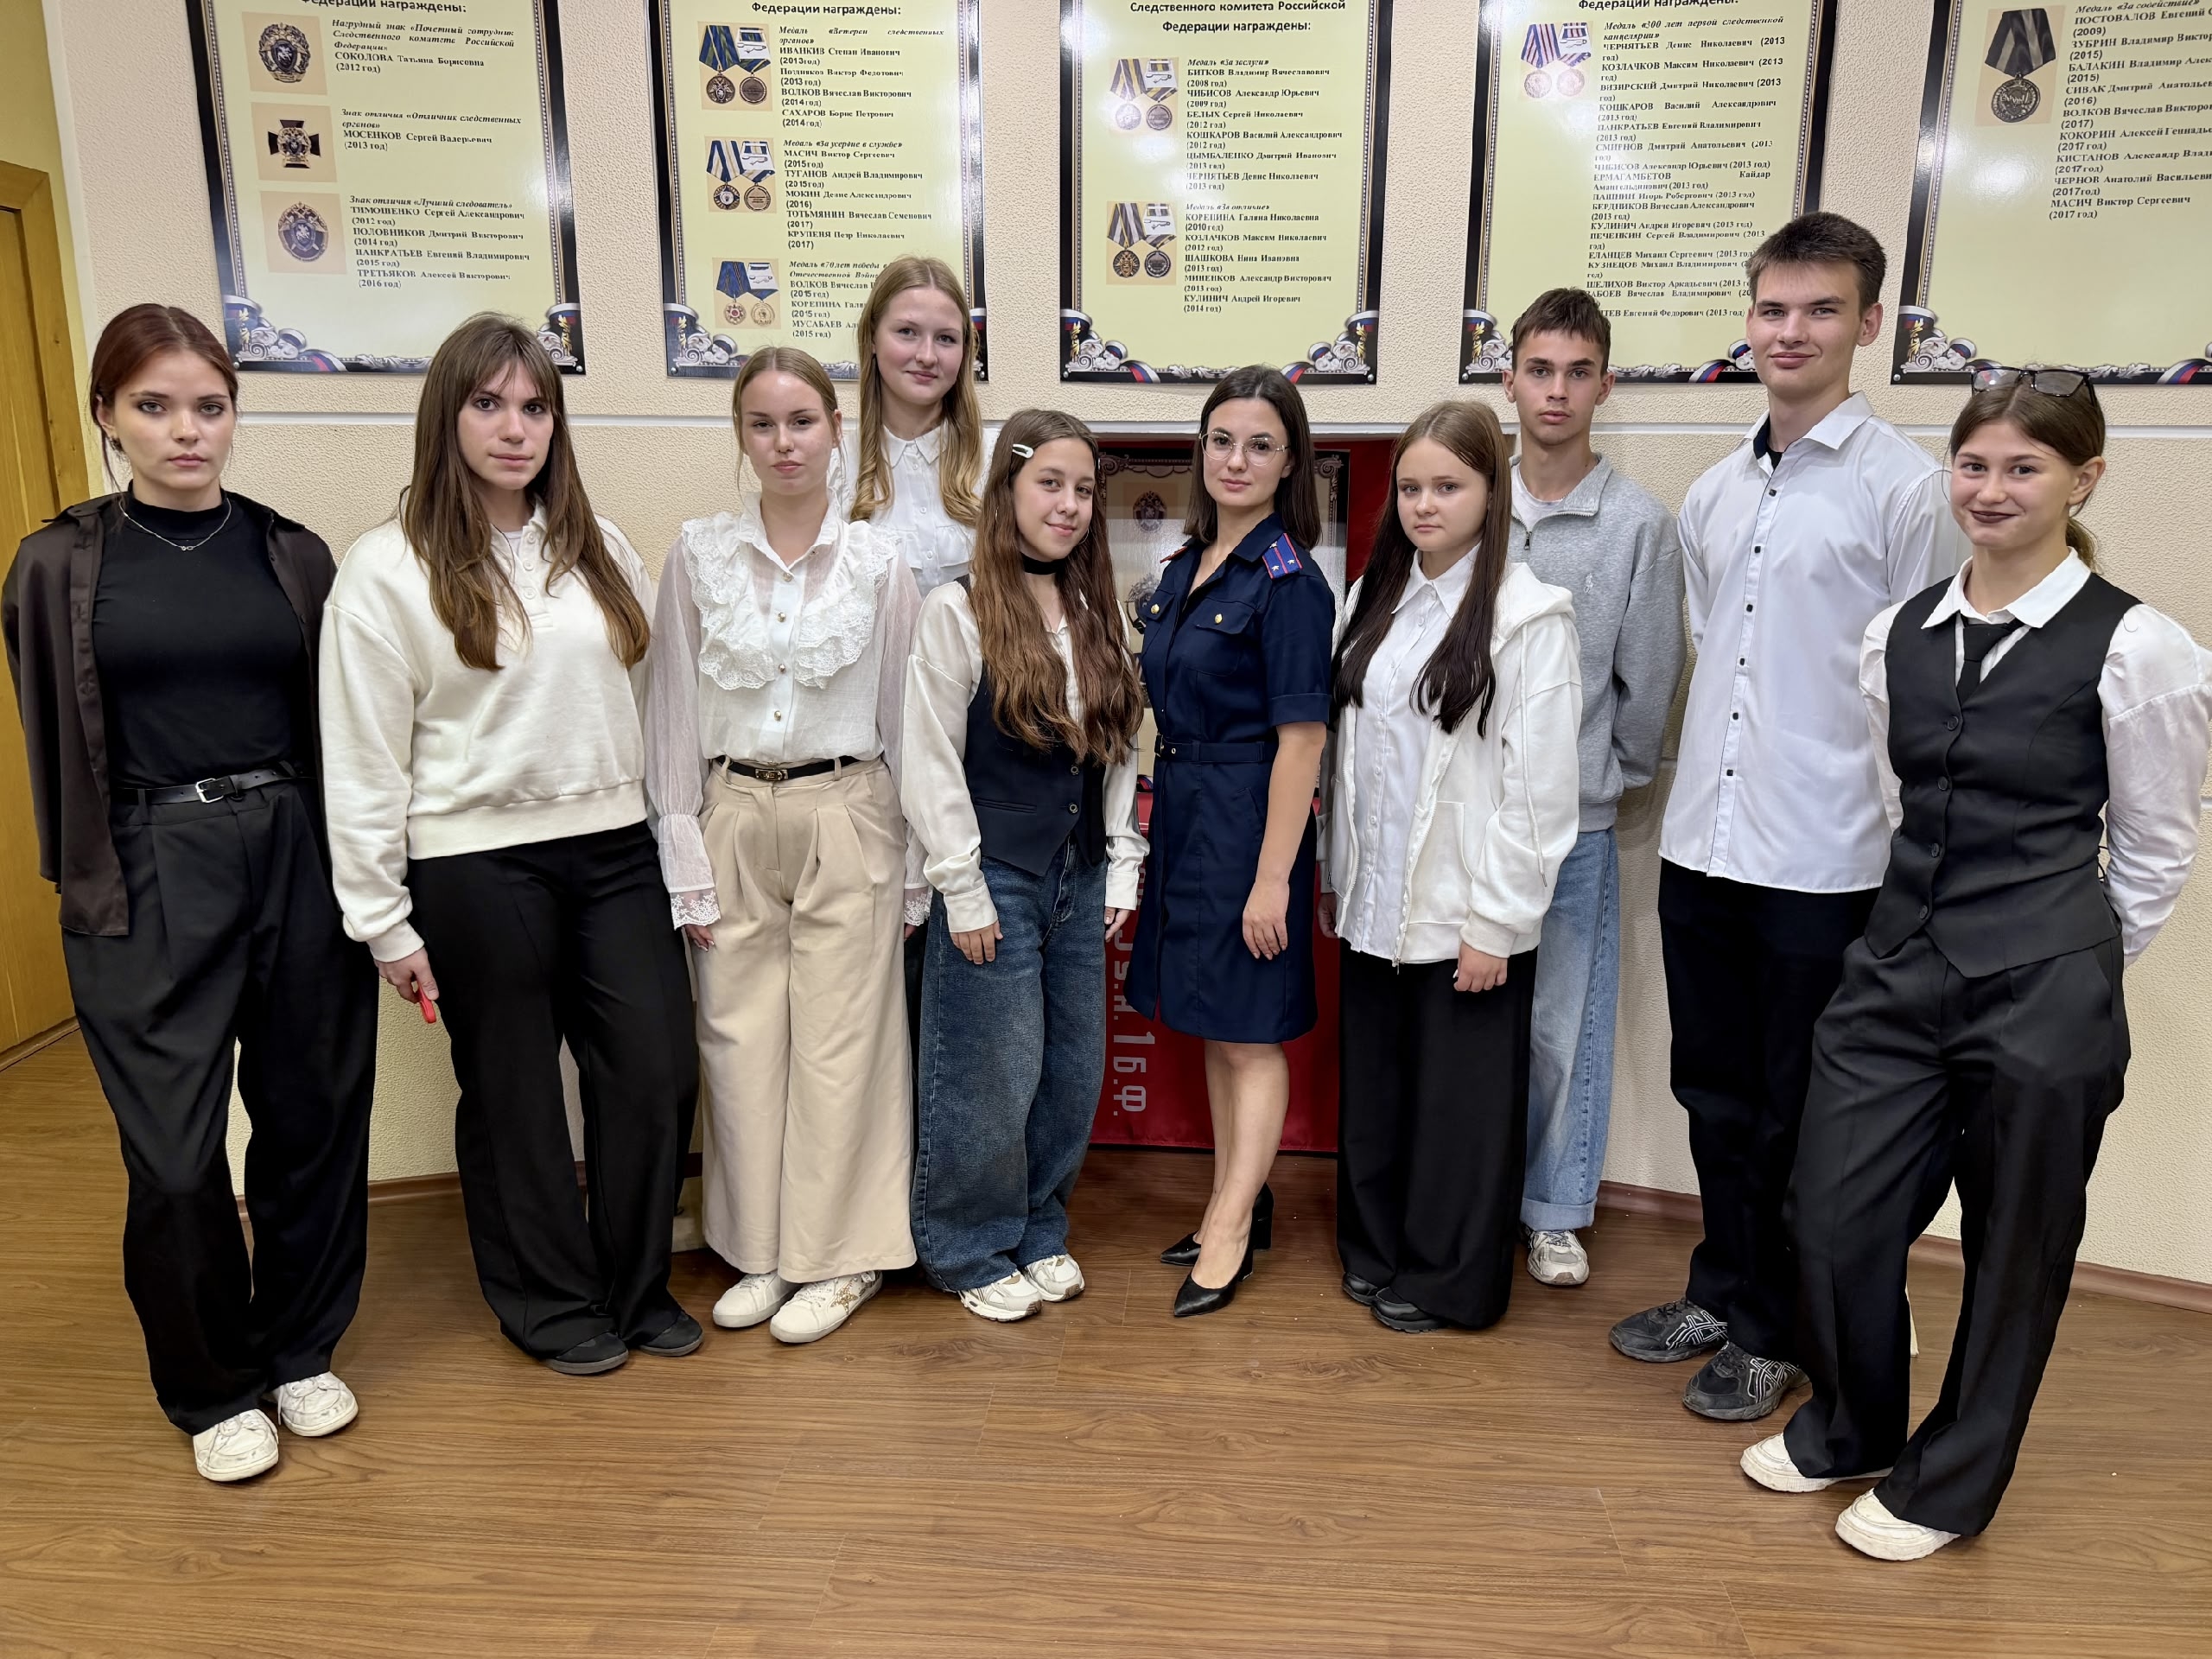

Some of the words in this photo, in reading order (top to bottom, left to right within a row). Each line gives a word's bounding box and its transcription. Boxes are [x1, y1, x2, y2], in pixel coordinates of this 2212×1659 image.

[380, 0, 467, 12] награждены:
[752, 2, 820, 15] Федерации
[823, 5, 901, 16] награждены:
[1130, 3, 1216, 14] Следственного
[1278, 0, 1345, 10] Российской
[1579, 0, 1649, 10] Федерации
[2075, 12, 2156, 24] ПОСТОВАЛОВ
[2161, 9, 2205, 19] Евгений
[1163, 21, 1229, 34] Федерации
[1233, 21, 1311, 33] награждены:
[2073, 27, 2106, 38] (2009)
[1761, 37, 1784, 47] (2013
[2072, 38, 2116, 48] ЗУБРИН
[2121, 35, 2173, 46] Владимир
[335, 52, 392, 62] СОКОЛОВА
[2069, 50, 2102, 60] (2015)
[1602, 62, 1660, 71] КОЗЛАЧКОВ
[2069, 60, 2124, 72] БАЛАКИН
[2129, 60, 2182, 69] Владимир
[781, 78, 803, 86] (2013
[1757, 79, 1781, 88] (2013
[2068, 73, 2099, 85] (2015)
[1236, 89, 1279, 98] Александр
[1281, 89, 1319, 98] Юрьевич
[2066, 85, 2106, 94] СИВАК
[2107, 83, 2152, 93] Дмитрий
[863, 90, 912, 99] Викторович
[2064, 97, 2096, 107] (2016)
[1223, 111, 1250, 119] Сергей
[2063, 107, 2110, 117] ВОЛКОВ
[2114, 105, 2163, 115] Вячеслав
[2062, 119, 2094, 130] (2017)
[344, 130, 401, 140] МОСЕНКОВ
[1243, 130, 1278, 139] Василий
[1281, 131, 1342, 140] Александрович
[2060, 130, 2115, 140] КОКОРИН
[2120, 128, 2163, 138] Алексей
[2056, 153, 2119, 162] КИСТАНОВ
[1730, 161, 1751, 169] (2013
[1739, 170, 1770, 179] Кайдар
[2055, 175, 2099, 184] ЧЕРНОВ
[2104, 175, 2152, 183] Анатолий
[2050, 199, 2091, 207] МАСИЧ
[2096, 198, 2133, 207] Виктор
[2137, 196, 2190, 207] Сергеевич
[424, 208, 455, 218] Сергей
[2050, 210, 2075, 220] (2017
[2077, 210, 2097, 219] год)
[353, 228, 425, 237] ПОЛОВНИКОВ
[1744, 230, 1764, 238] (2013
[356, 249, 423, 257] ПАНКРАТЬЕВ
[1589, 251, 1632, 260] ЕЛАНЦЕВ
[359, 279, 381, 288] (2016
[1637, 280, 1665, 289] Виктор
[1719, 279, 1741, 288] (2013
[1707, 308, 1726, 317] (2013
